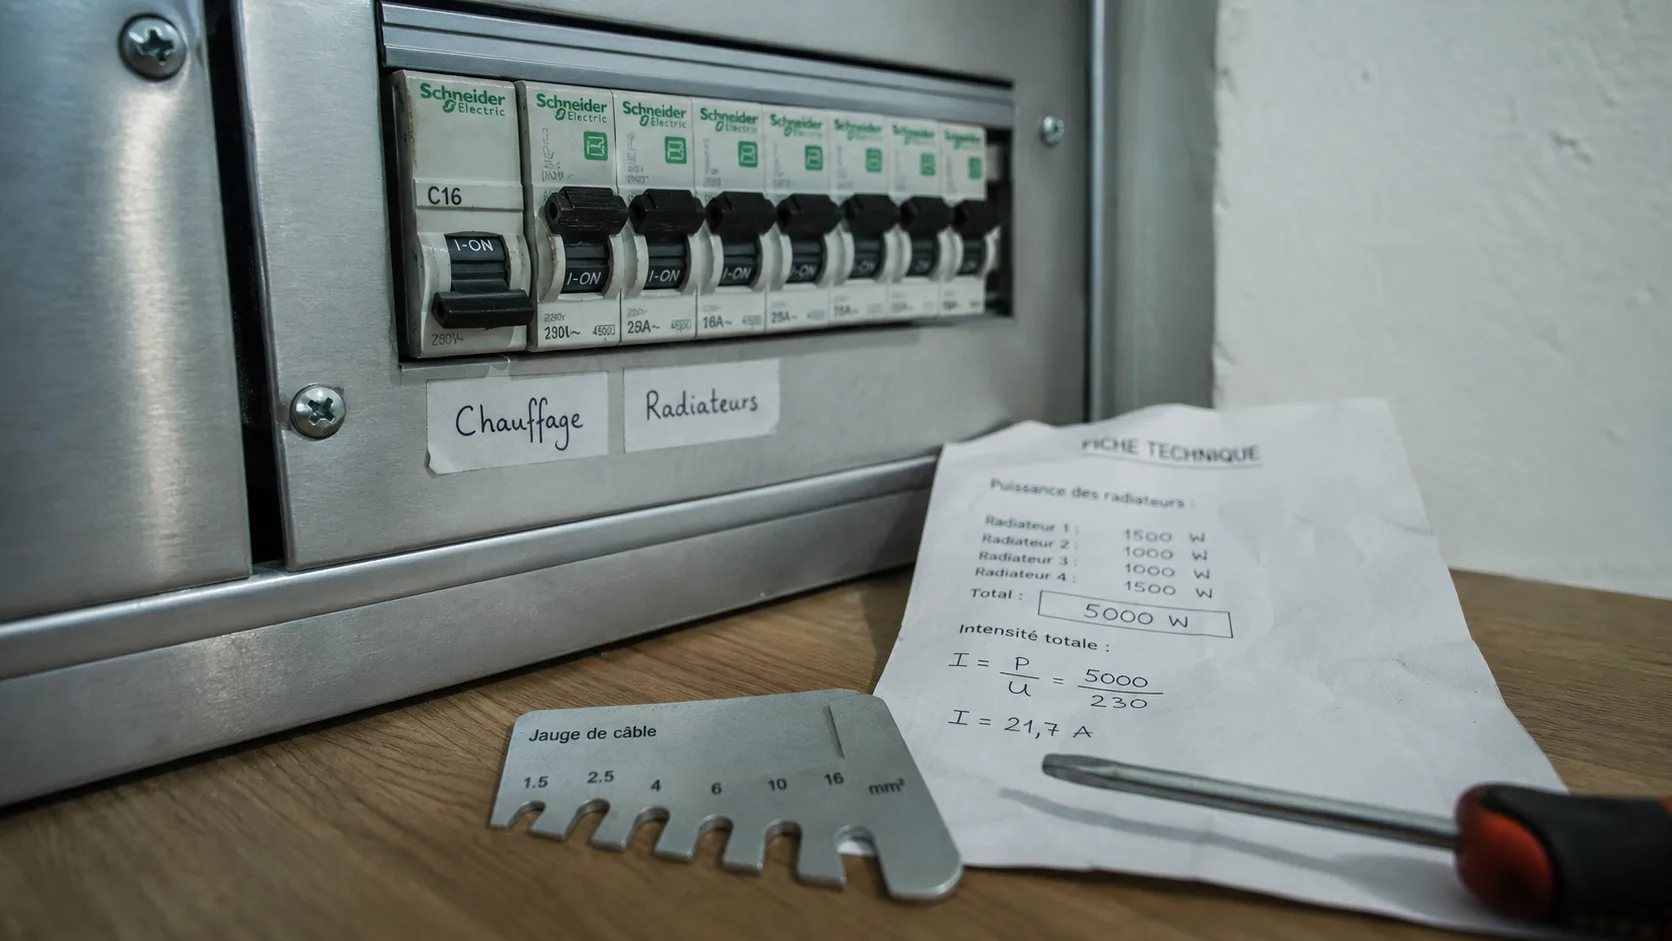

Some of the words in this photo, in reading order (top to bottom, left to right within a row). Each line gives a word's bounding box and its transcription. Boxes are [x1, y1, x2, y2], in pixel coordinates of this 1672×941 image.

[419, 82, 506, 106] Schneider
[536, 93, 608, 114] Schneider
[458, 103, 506, 117] Electric
[567, 111, 608, 124] Electric
[622, 100, 687, 119] Schneider
[700, 107, 758, 125] Schneider
[651, 118, 687, 129] Electric
[427, 186, 462, 206] C16
[646, 388, 759, 421] Radiateurs
[455, 397, 584, 451] Chauffage
[1081, 437, 1139, 455] FICHE
[1147, 440, 1261, 463] TECHNIQUE
[990, 478, 1066, 498] Puissance
[1071, 486, 1099, 501] des
[1103, 491, 1185, 509] radiateurs
[985, 514, 1056, 533] Radiateur
[981, 533, 1054, 549] Radiateur
[1060, 540, 1069, 550] 2
[1124, 528, 1174, 543] 1500
[1189, 531, 1205, 543] W
[978, 551, 1053, 565] Radiateur
[1059, 555, 1068, 566] 3
[1124, 546, 1174, 560] 1000
[1191, 549, 1207, 561] W
[975, 566, 1052, 581] Radiateur
[1057, 572, 1067, 582] 4
[1124, 562, 1176, 578] 1000
[1193, 568, 1210, 580] W
[970, 588, 1013, 600] Total
[1124, 580, 1177, 596] 1500
[1195, 587, 1213, 599] W
[1083, 603, 1154, 625] 5000
[1168, 614, 1189, 628] W
[959, 624, 1038, 641] Intensité
[1045, 634, 1098, 651] totale
[948, 651, 970, 668] I
[1014, 656, 1030, 671] P
[1083, 668, 1149, 689] 5000
[1090, 694, 1148, 710] 230
[948, 709, 970, 726] I
[1003, 716, 1060, 740] 21,7
[1073, 725, 1094, 739] A
[528, 728, 581, 744] Jauge
[586, 727, 608, 740] de
[613, 725, 657, 739] câble
[523, 775, 549, 790] 1.5
[586, 770, 615, 784] 2.5
[650, 779, 662, 792] 4
[710, 782, 723, 796] 6
[767, 778, 788, 792] 10
[823, 772, 845, 786] 16
